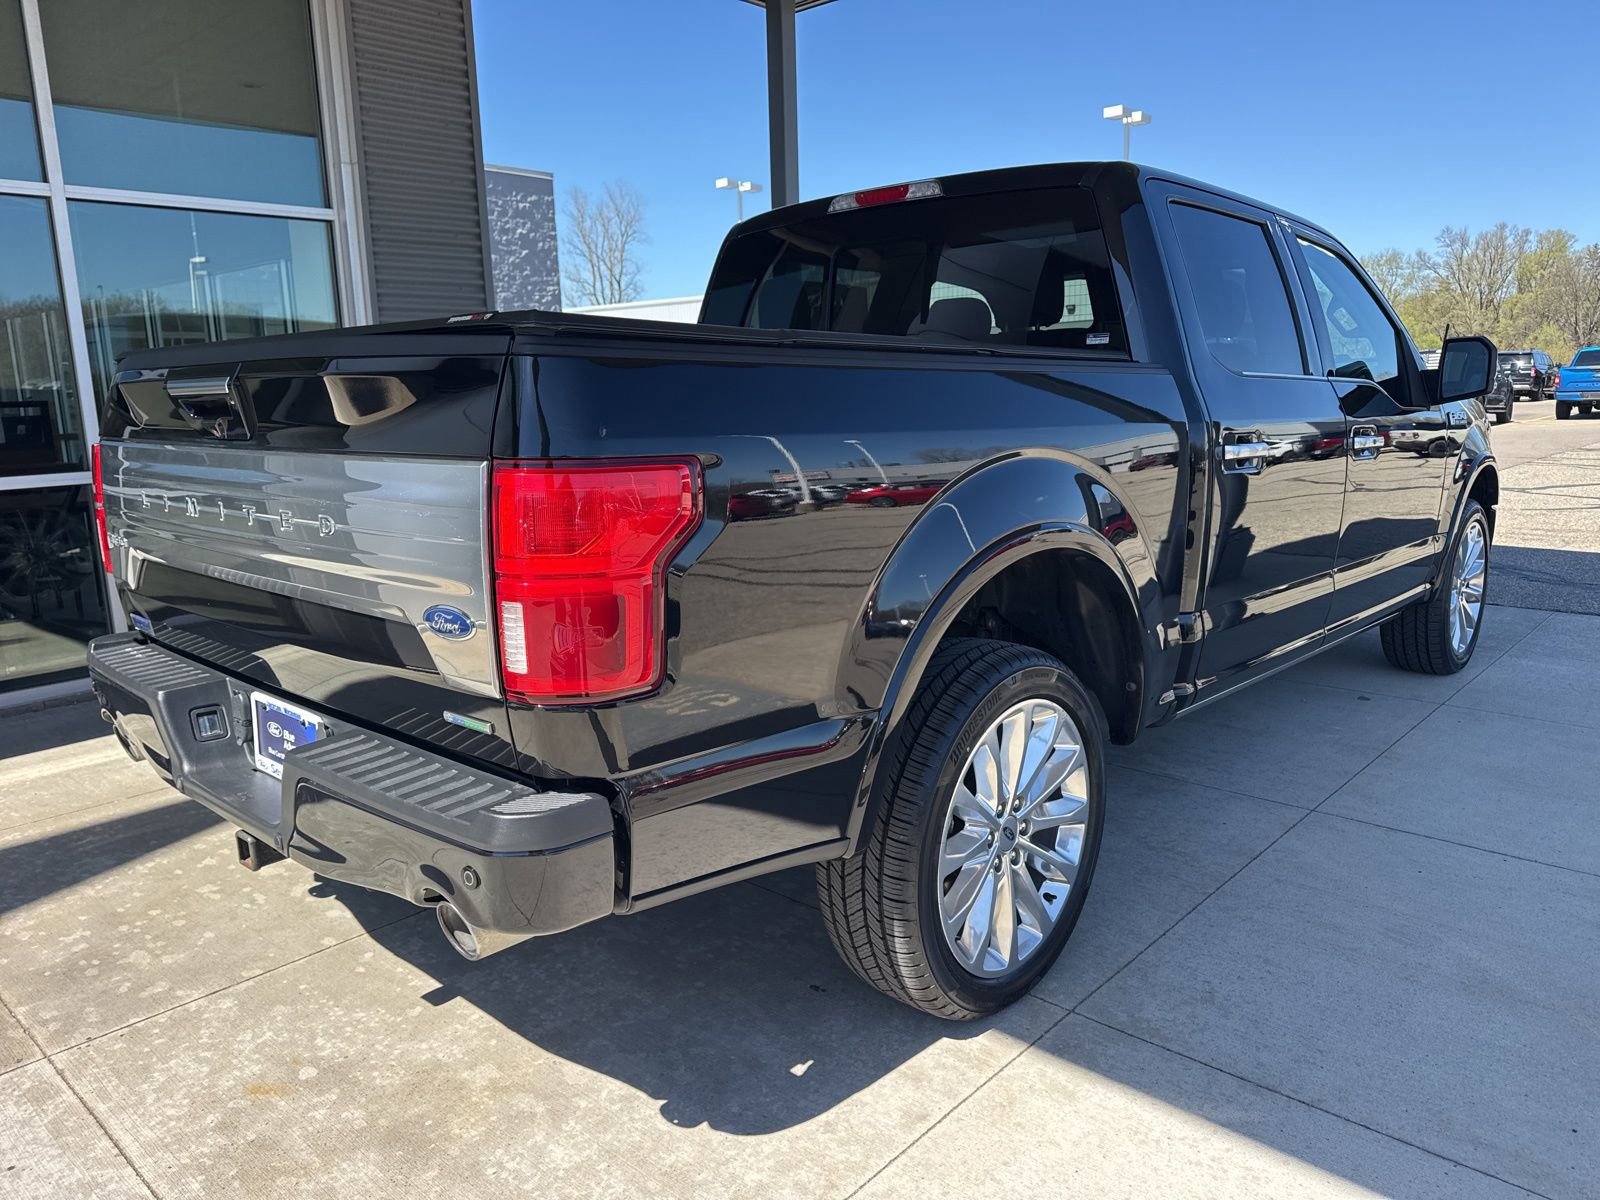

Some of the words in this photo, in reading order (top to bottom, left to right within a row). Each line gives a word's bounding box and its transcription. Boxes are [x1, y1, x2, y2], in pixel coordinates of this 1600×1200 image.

[141, 490, 336, 537] LIMITED
[431, 611, 461, 635] Ford
[949, 687, 1003, 766] BRIDGESTONE
